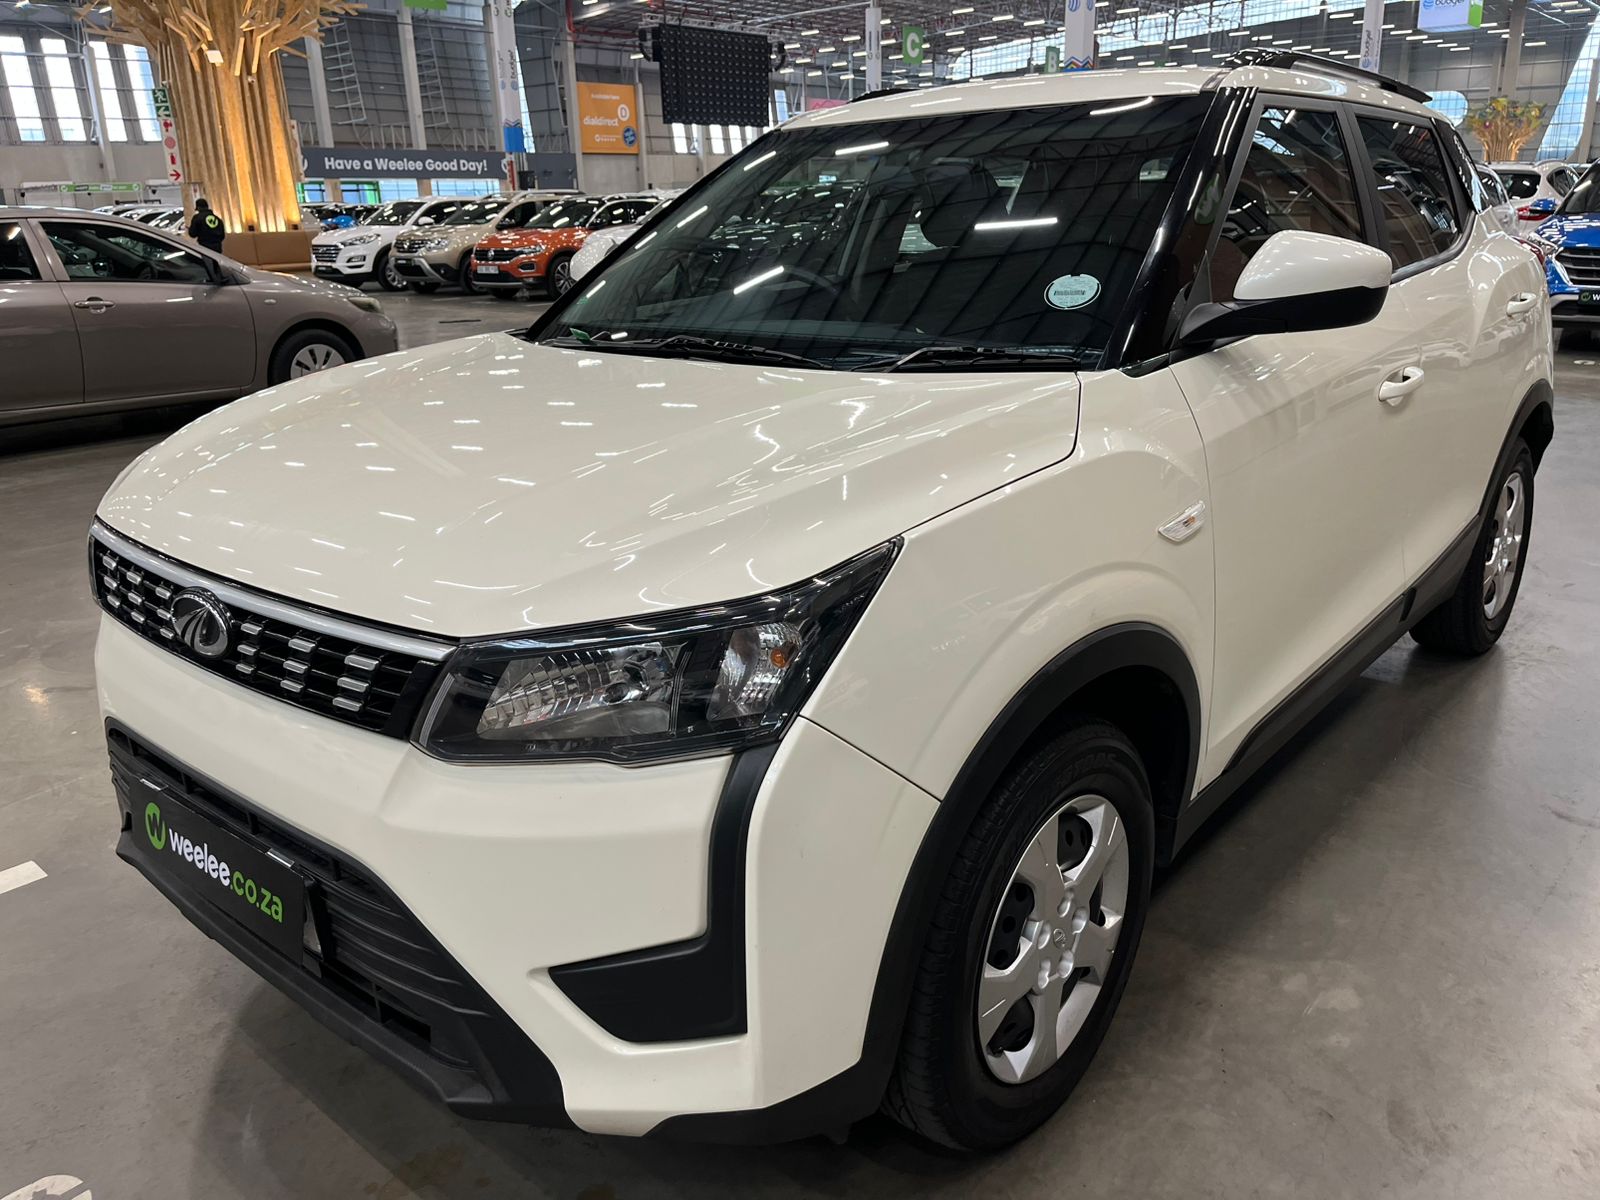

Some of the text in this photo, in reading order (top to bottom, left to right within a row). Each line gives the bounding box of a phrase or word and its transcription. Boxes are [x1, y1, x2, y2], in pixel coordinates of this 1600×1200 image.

[906, 32, 920, 58] C
[1047, 51, 1057, 73] B
[324, 157, 488, 175] Have a Weelee Good Day!
[168, 828, 284, 923] weelee.co.za
